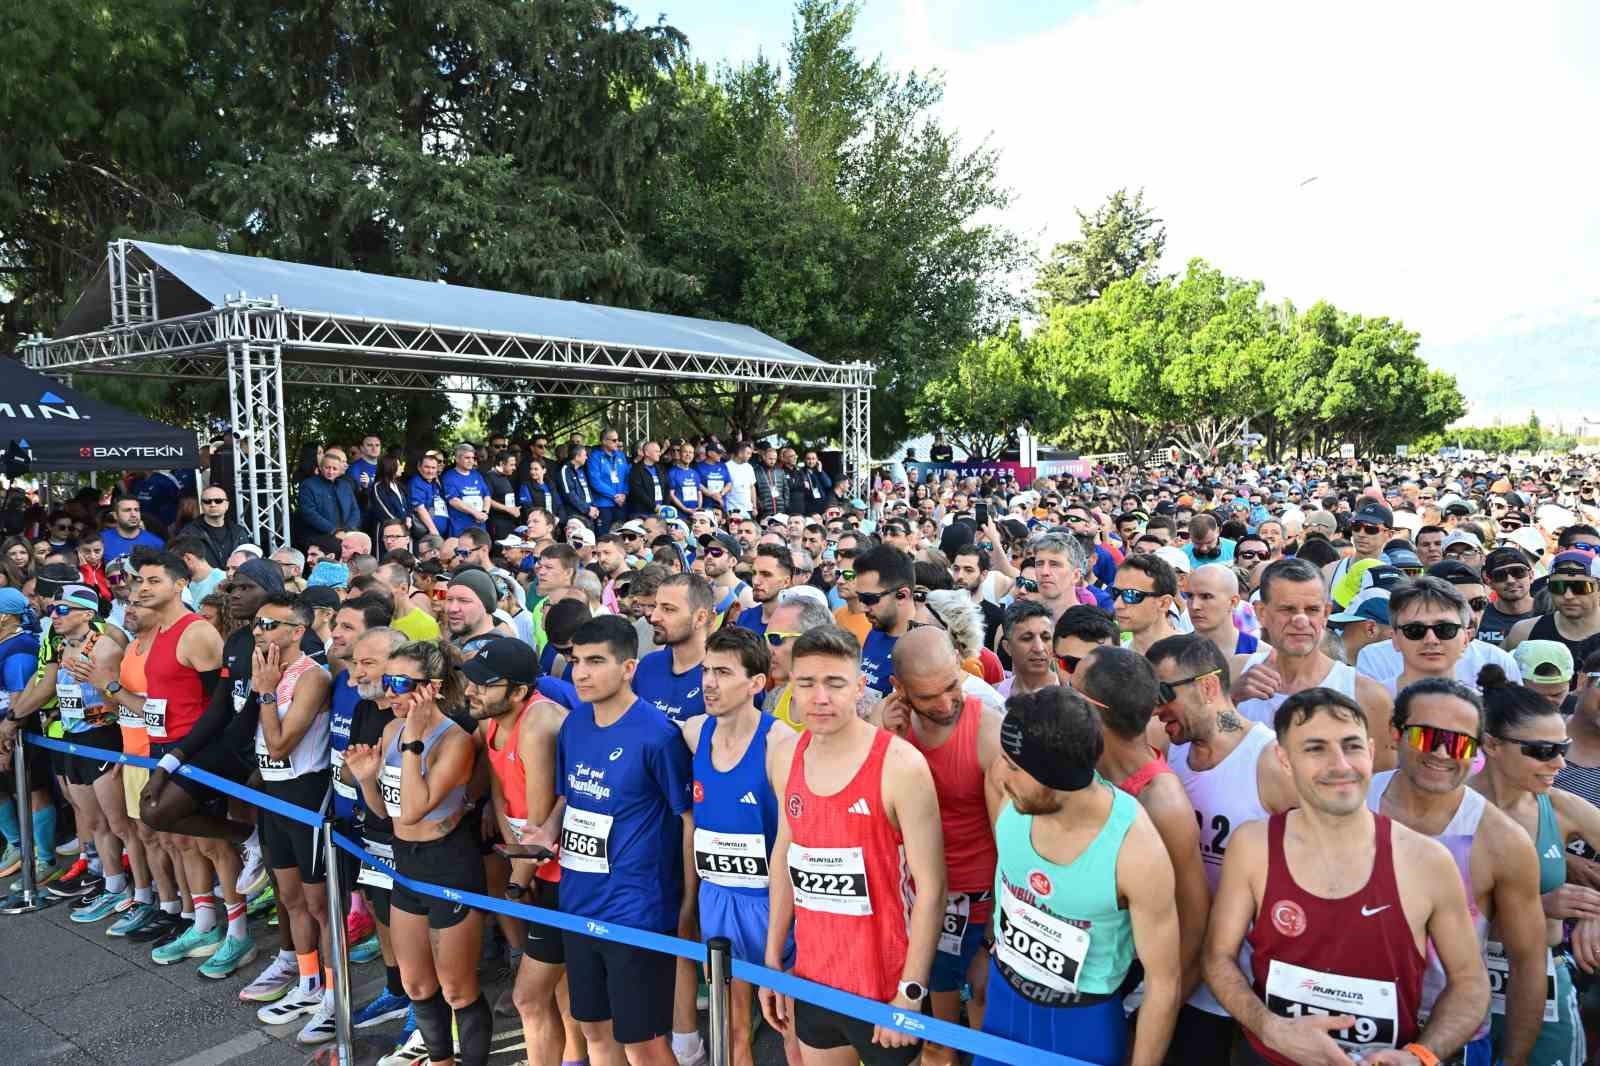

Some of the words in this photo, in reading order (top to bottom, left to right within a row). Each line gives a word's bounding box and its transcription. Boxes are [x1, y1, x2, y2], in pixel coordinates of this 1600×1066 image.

[93, 445, 183, 457] BAYTEKİN
[564, 830, 598, 856] 1566
[705, 854, 758, 874] 1519
[797, 871, 857, 895] 2222
[1003, 919, 1065, 974] 2068
[1312, 984, 1365, 1001] RUNTALTA
